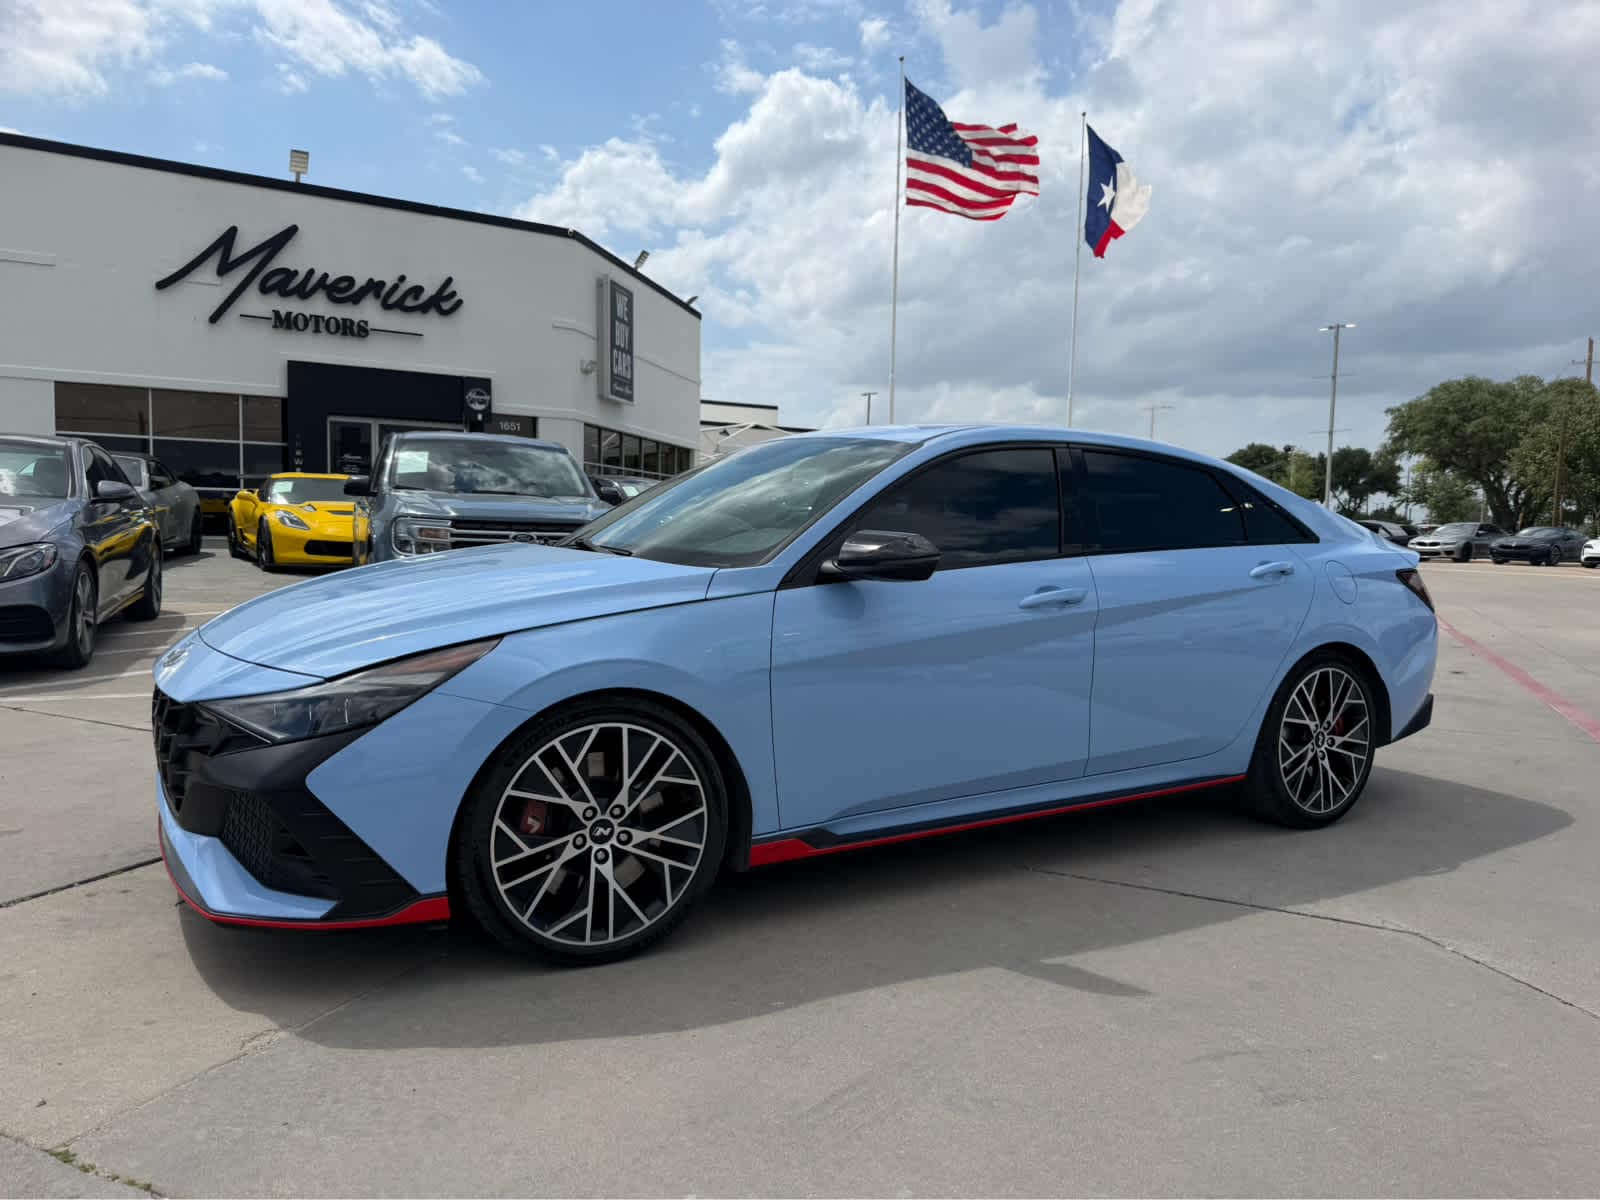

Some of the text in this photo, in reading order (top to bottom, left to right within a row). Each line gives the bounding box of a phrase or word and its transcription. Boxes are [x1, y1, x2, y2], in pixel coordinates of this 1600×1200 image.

[155, 224, 464, 324] Maverick
[271, 309, 370, 338] MOTORS
[613, 349, 631, 379] CARS
[499, 421, 521, 432] 1651
